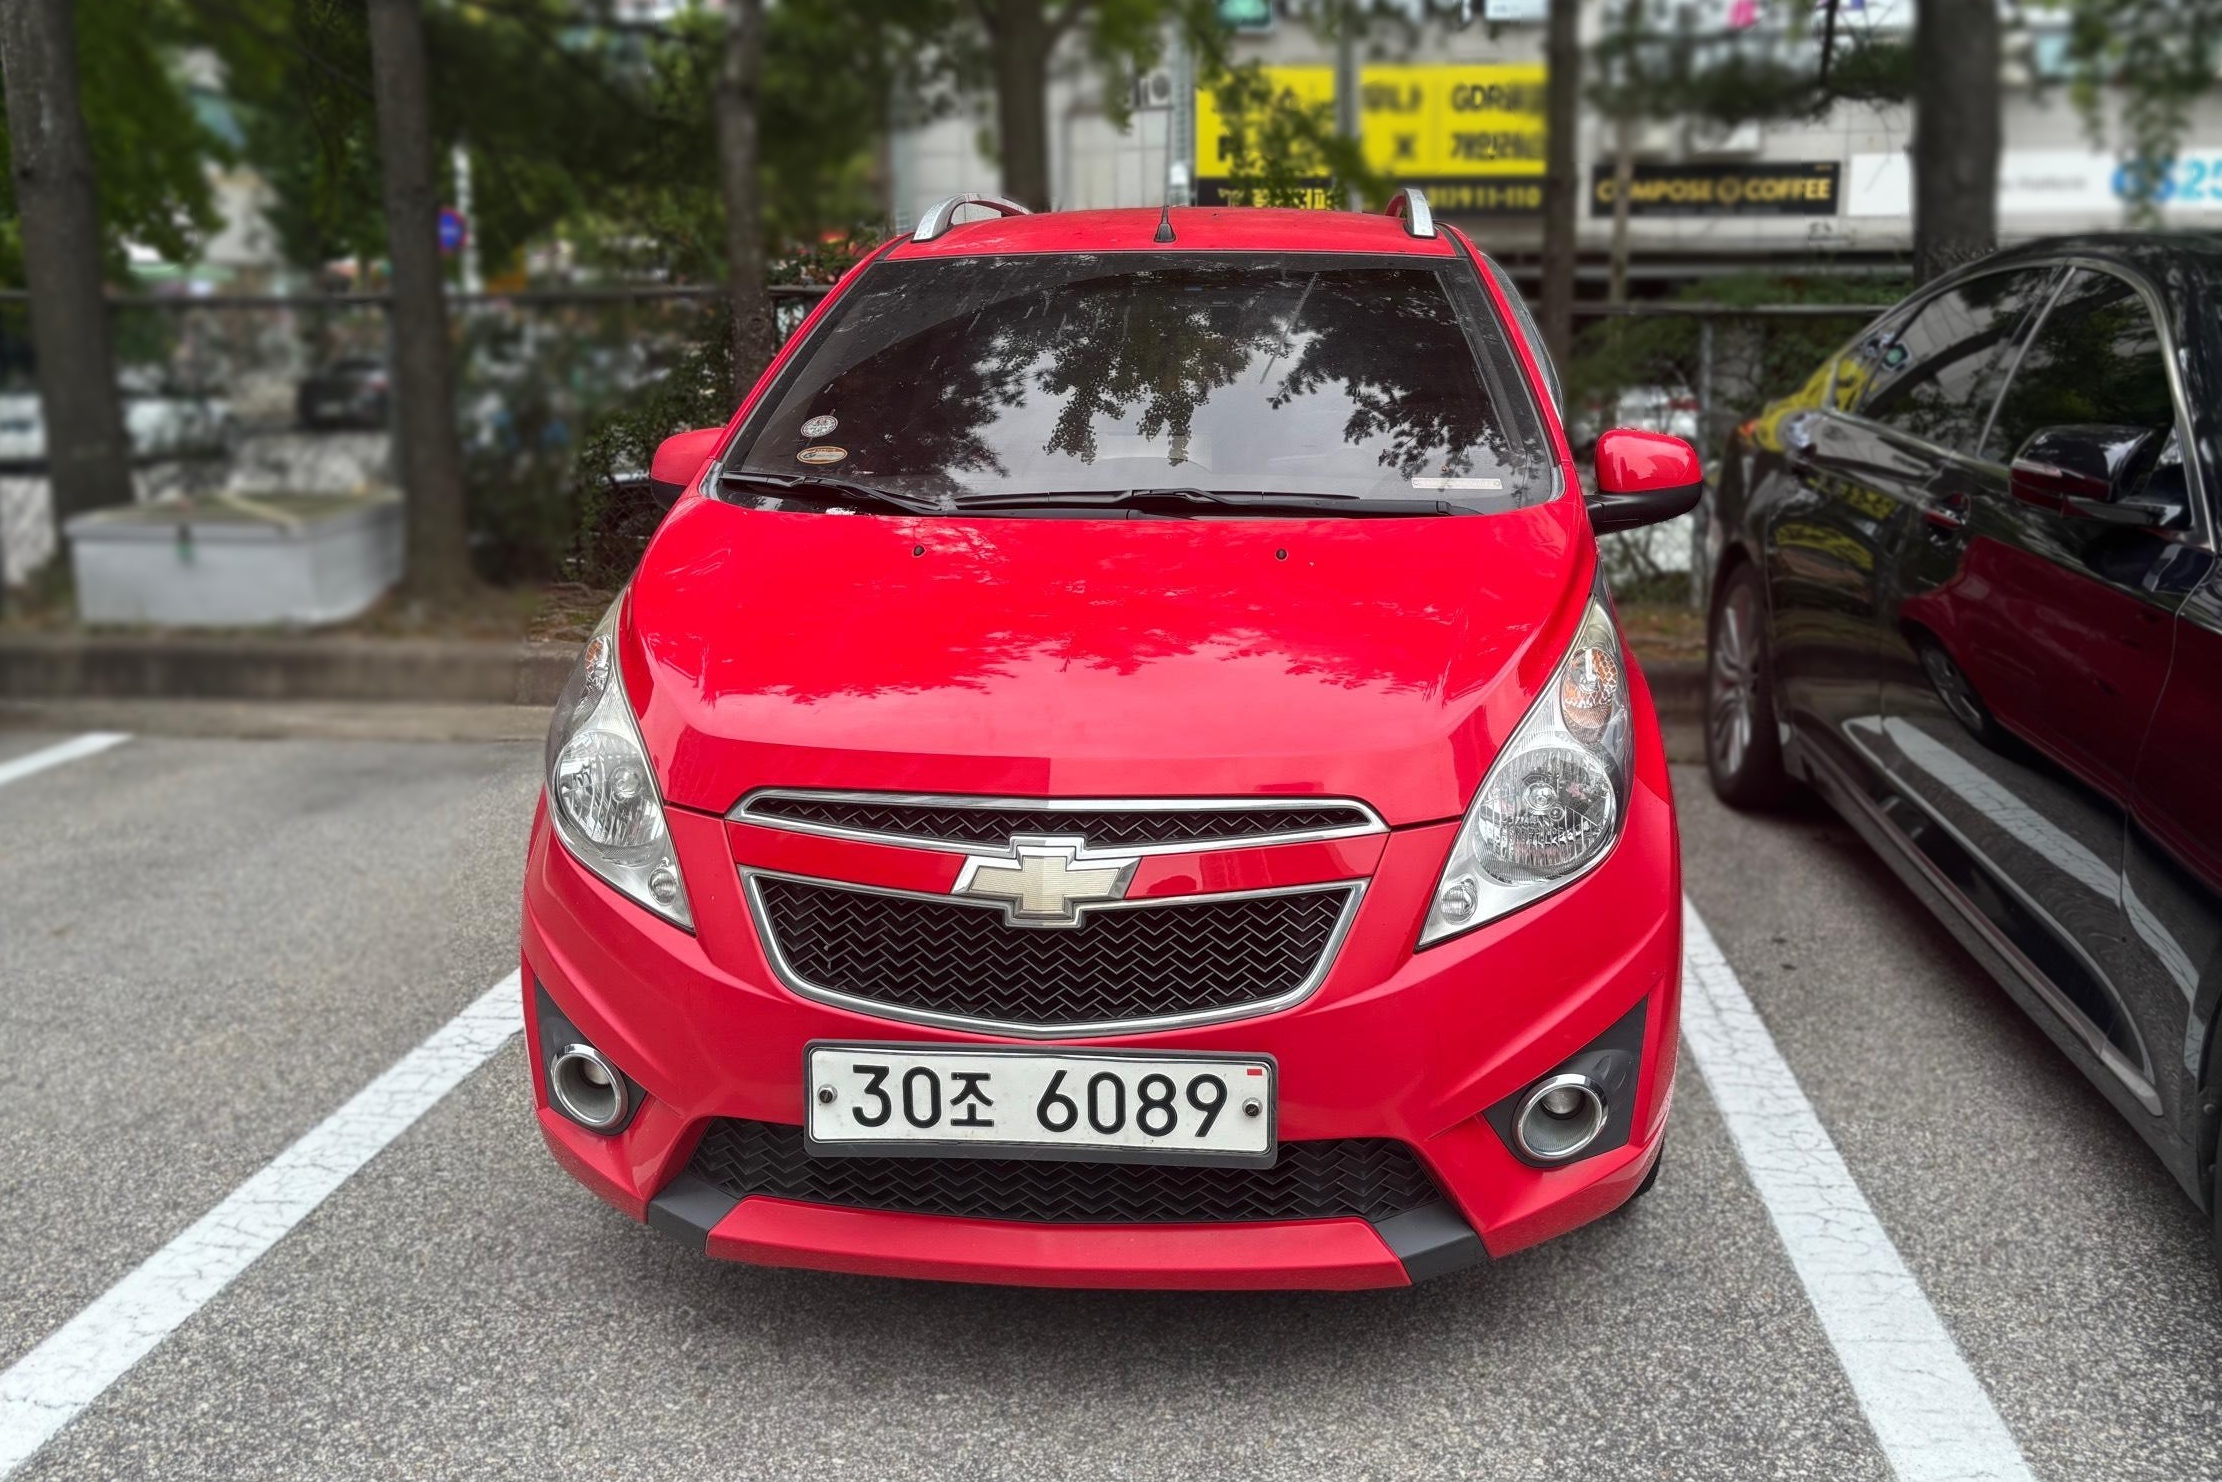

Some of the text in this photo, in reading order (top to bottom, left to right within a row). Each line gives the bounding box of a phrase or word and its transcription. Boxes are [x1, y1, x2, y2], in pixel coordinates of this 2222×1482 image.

[1597, 177, 1832, 203] CMPOSE COFFEE
[851, 1063, 1228, 1138] 30조 6089
